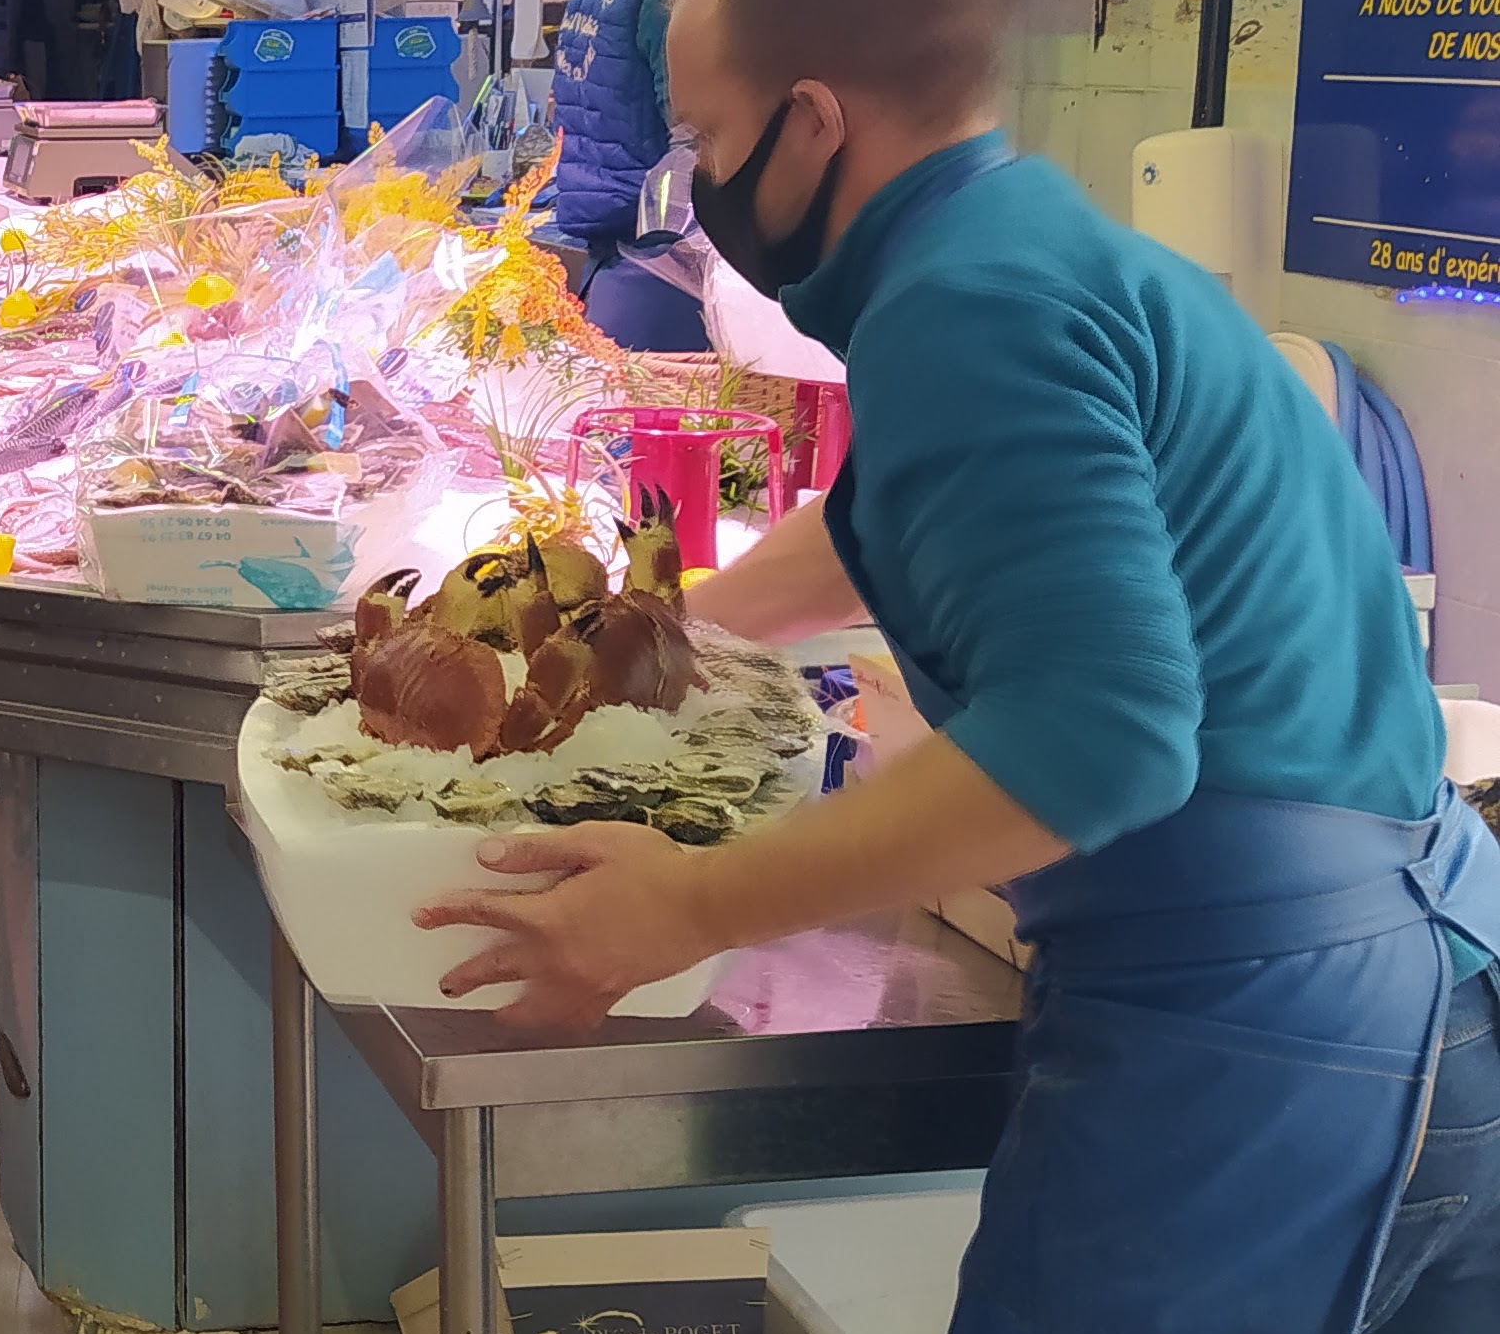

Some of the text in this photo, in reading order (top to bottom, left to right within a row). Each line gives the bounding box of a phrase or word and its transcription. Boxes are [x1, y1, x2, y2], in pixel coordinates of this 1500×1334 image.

[1428, 31, 1500, 61] DE NOS
[1370, 239, 1392, 270] 28
[1395, 250, 1425, 274] ans
